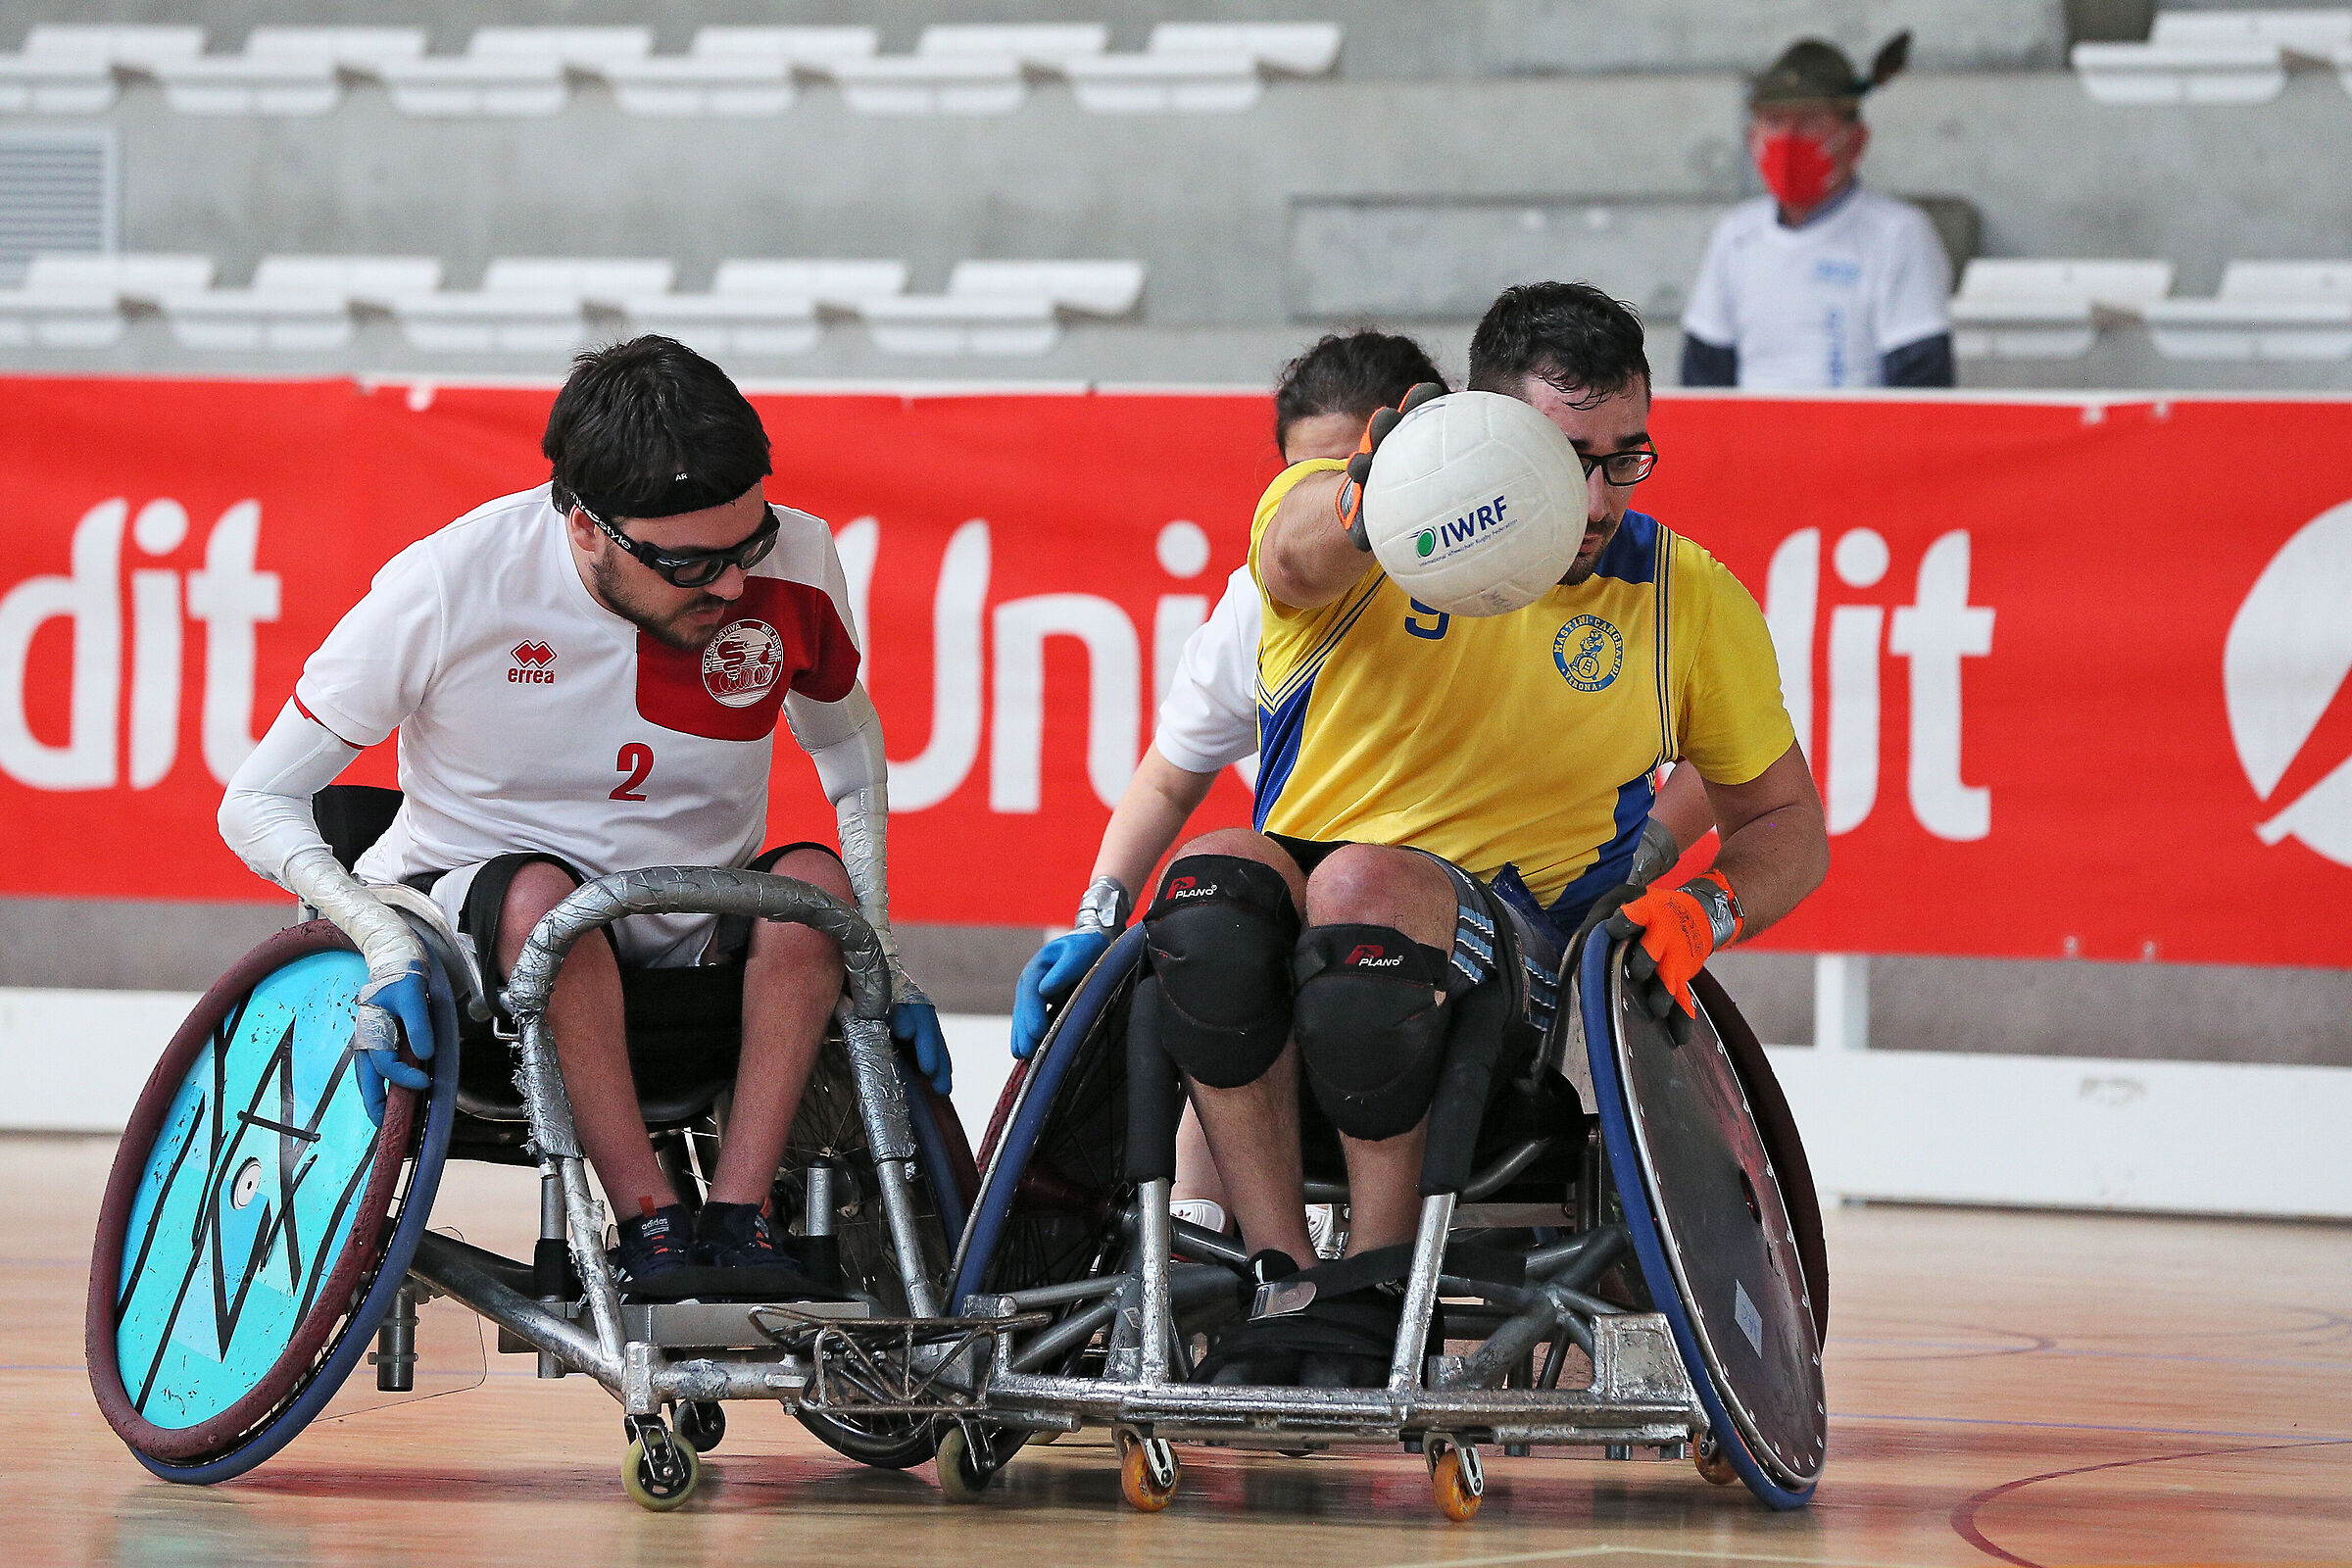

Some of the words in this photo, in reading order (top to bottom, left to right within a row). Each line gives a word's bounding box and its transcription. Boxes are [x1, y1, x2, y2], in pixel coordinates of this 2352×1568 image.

[1441, 495, 1507, 548] IWRF
[704, 623, 742, 674] POLISPORTIVA
[760, 624, 782, 662] MILANESE
[1554, 615, 1589, 654] MASTINI
[1593, 618, 1623, 678] CANGRANDI
[1565, 671, 1598, 690] VERONA
[608, 742, 655, 802] 2
[1175, 888, 1214, 900] PLANO
[1358, 957, 1400, 967] PLANO
[641, 1218, 668, 1231] adidas
